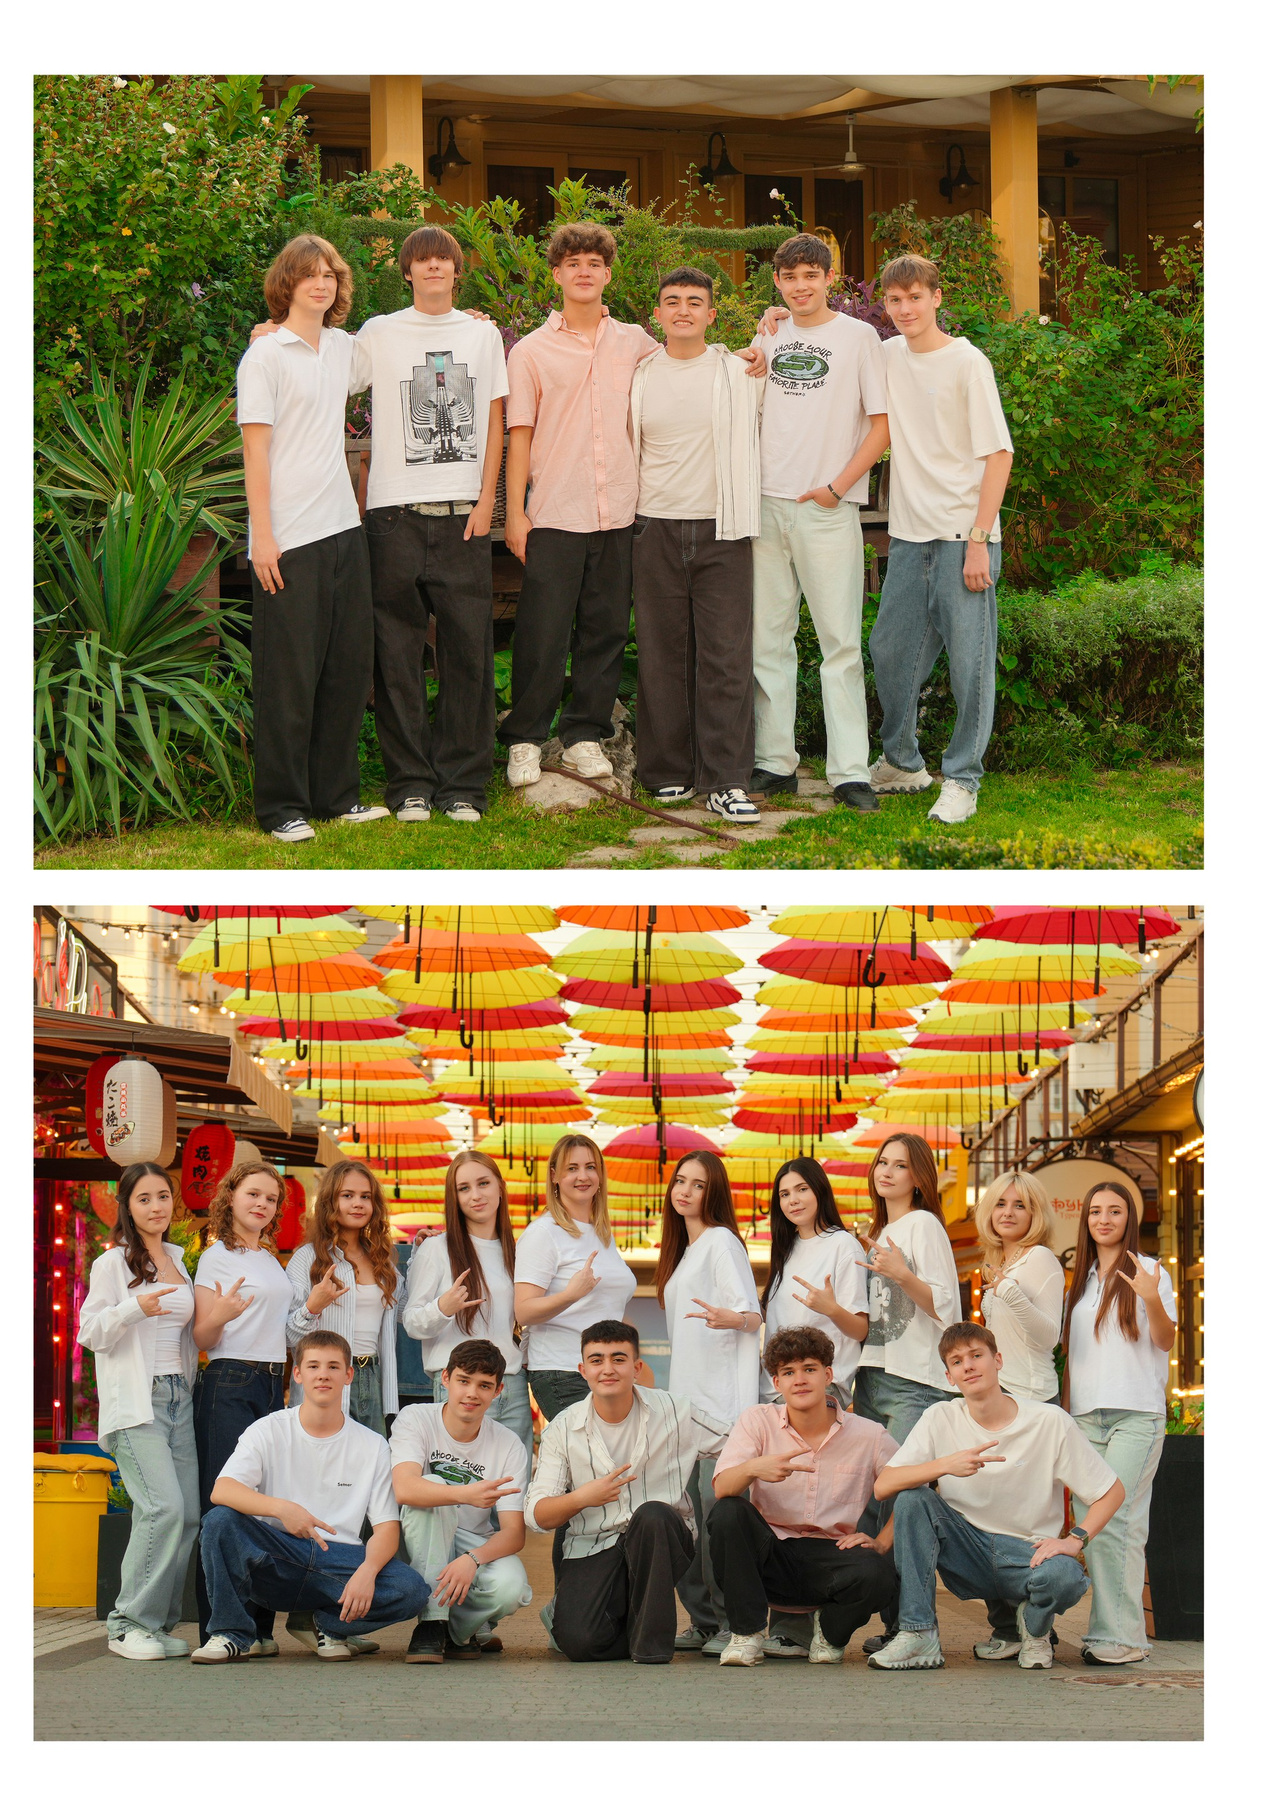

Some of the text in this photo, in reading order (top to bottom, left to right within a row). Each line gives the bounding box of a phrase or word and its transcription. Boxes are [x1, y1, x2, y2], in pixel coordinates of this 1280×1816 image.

[774, 341, 832, 361] CHOOSE YOUR
[769, 373, 827, 390] FAVORITE PLACE
